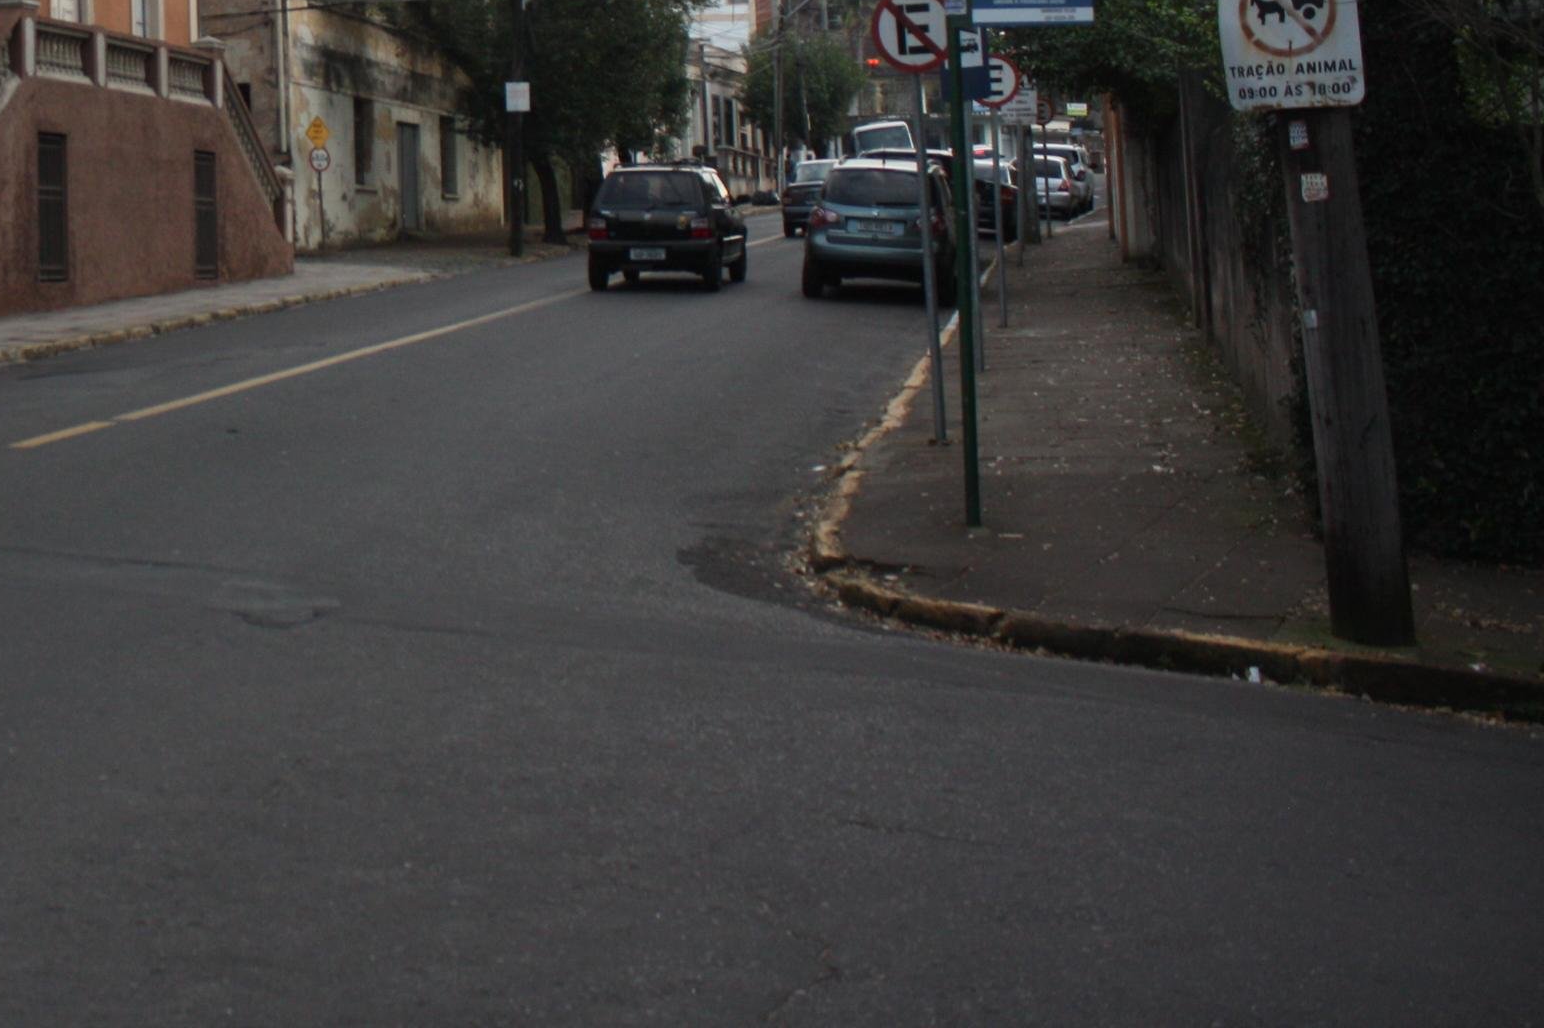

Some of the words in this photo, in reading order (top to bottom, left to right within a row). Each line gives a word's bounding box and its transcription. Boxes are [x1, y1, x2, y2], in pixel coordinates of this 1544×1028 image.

[1229, 60, 1286, 80] TRAÇÃO
[1295, 59, 1357, 76] ANIMAL
[1239, 86, 1278, 100] 09:00
[1309, 82, 1352, 96] 18:00
